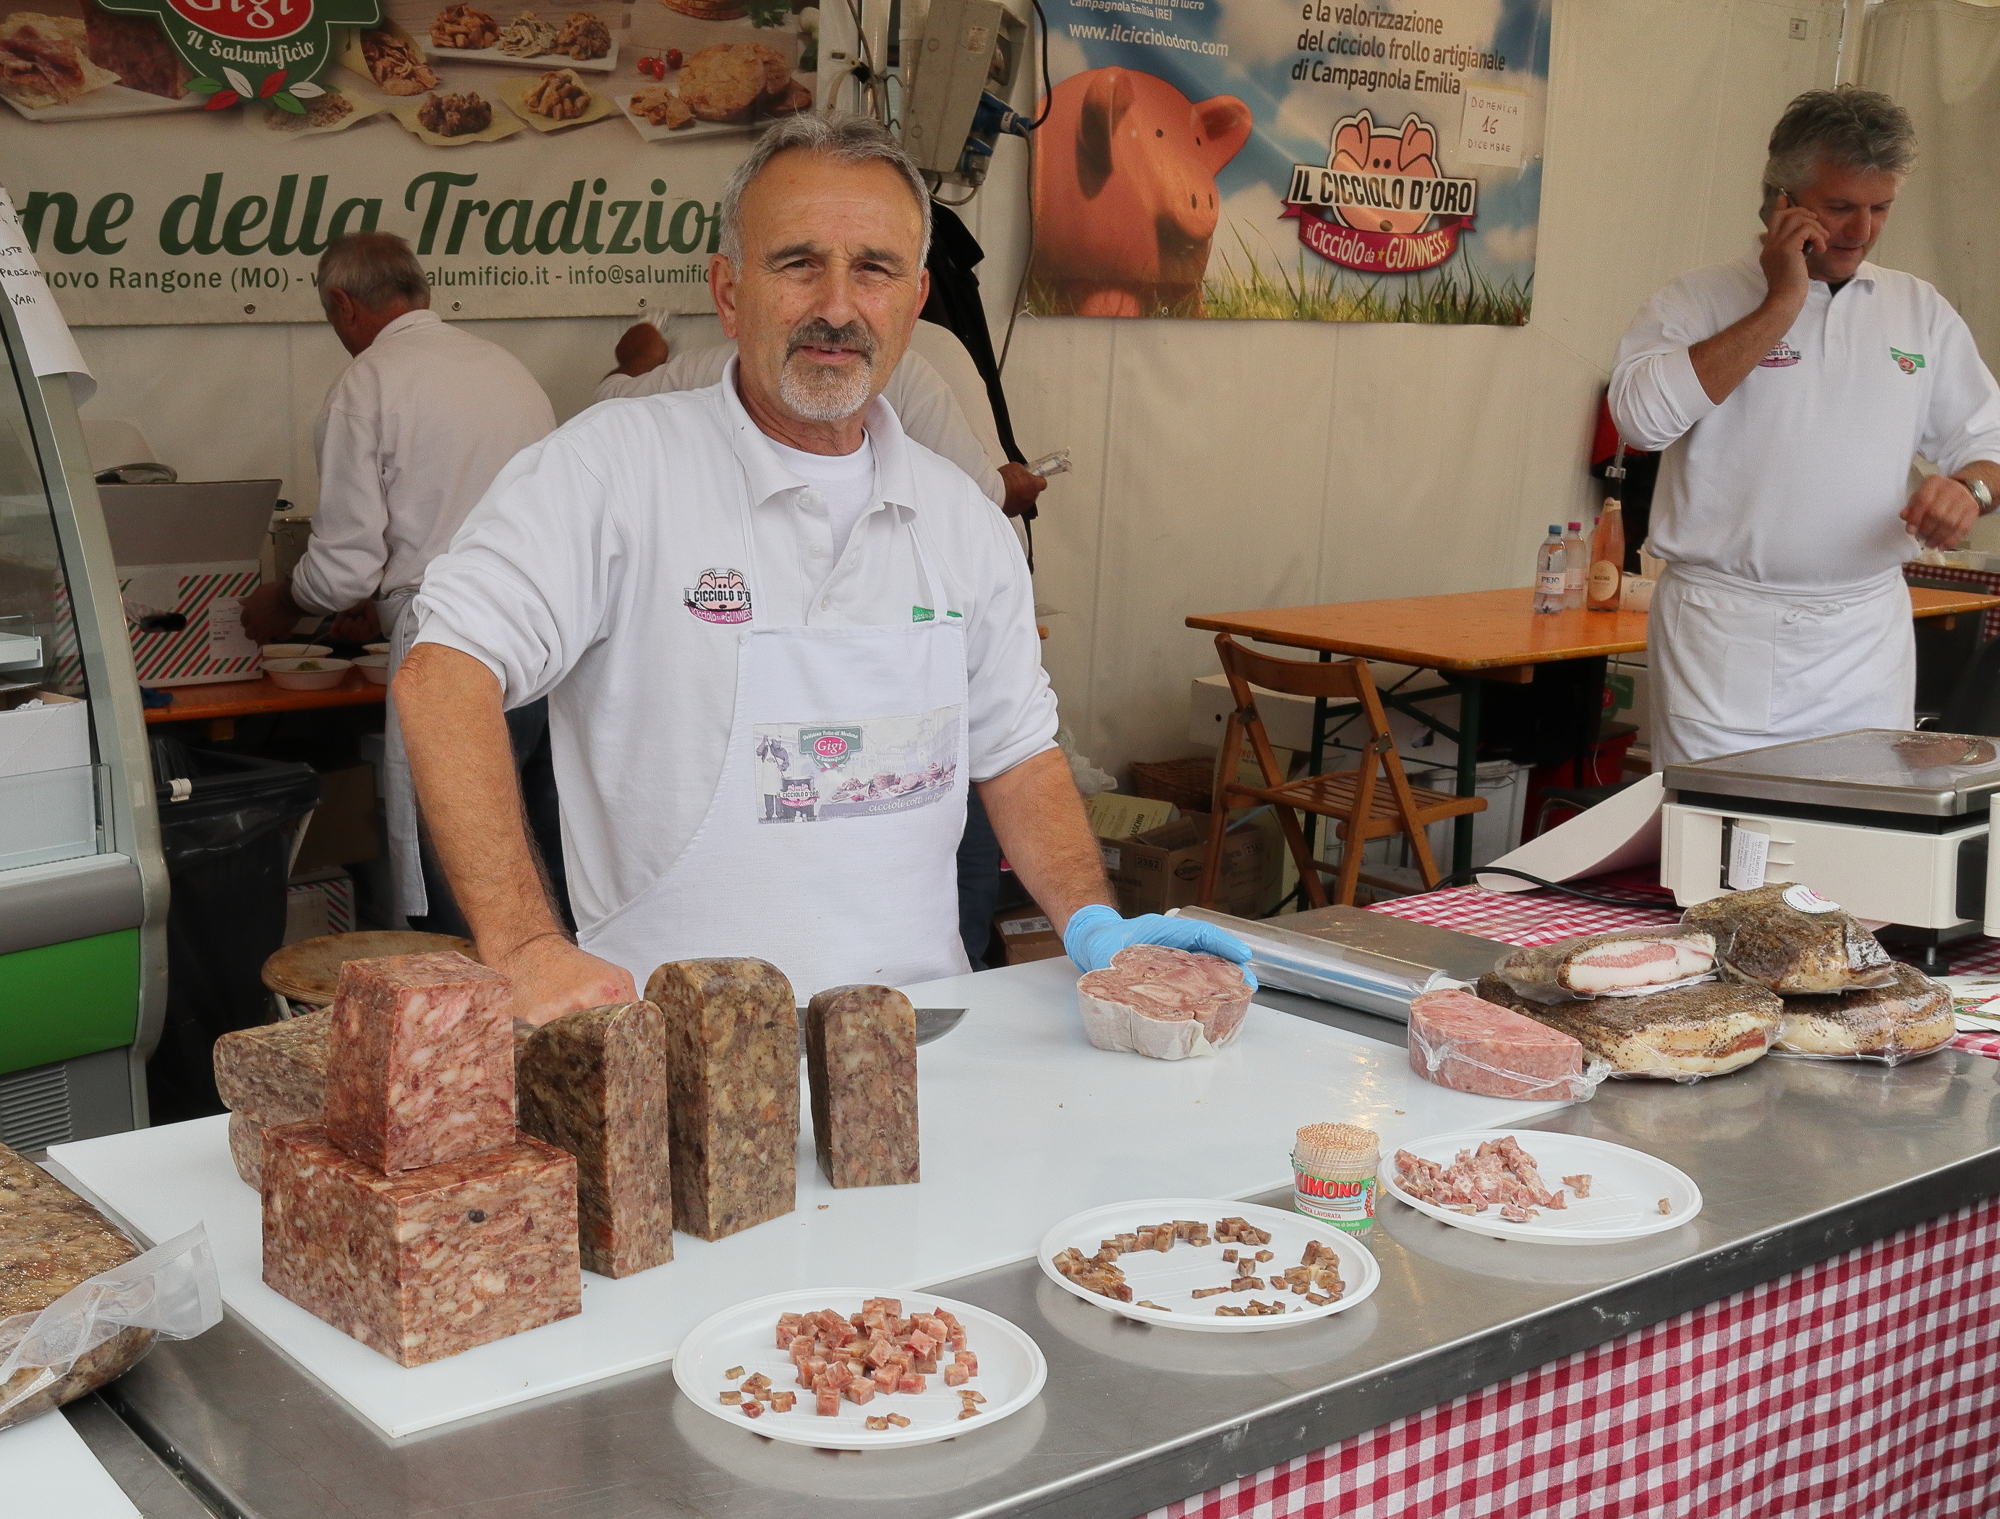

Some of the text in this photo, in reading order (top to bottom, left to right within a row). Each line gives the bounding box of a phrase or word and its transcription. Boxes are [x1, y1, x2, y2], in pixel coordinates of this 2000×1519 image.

[1131, 4, 1154, 17] Emilia
[1302, 0, 1443, 35] e la valorizzazione
[186, 30, 315, 70] Il Salumificio
[1069, 23, 1229, 57] www.ilcicciolodoro.com
[1297, 29, 1506, 72] del cicciolo frollo artigianale
[1291, 58, 1461, 94] di Campagnola Emilia
[1482, 115, 1500, 134] 16
[1468, 138, 1511, 153] DICEMBRE
[1292, 170, 1472, 213] IL CICCIOLO D'ORO
[17, 190, 135, 256] ne
[159, 172, 383, 256] della
[1311, 222, 1365, 265] Cicciolo
[1365, 250, 1375, 263] da
[1385, 231, 1447, 269] GUINNESS
[109, 266, 222, 293] Rangone
[231, 266, 289, 293] (MO)
[427, 263, 550, 287] alumificio.it
[11, 293, 36, 306] VARI
[694, 590, 734, 602] CICCIOLO
[737, 591, 751, 601] D'O
[817, 740, 842, 754] Gigi
[868, 799, 905, 813] ciccioli
[1138, 857, 1159, 869] 2362
[1300, 1204, 1342, 1219] PUNTA LAVORATA
